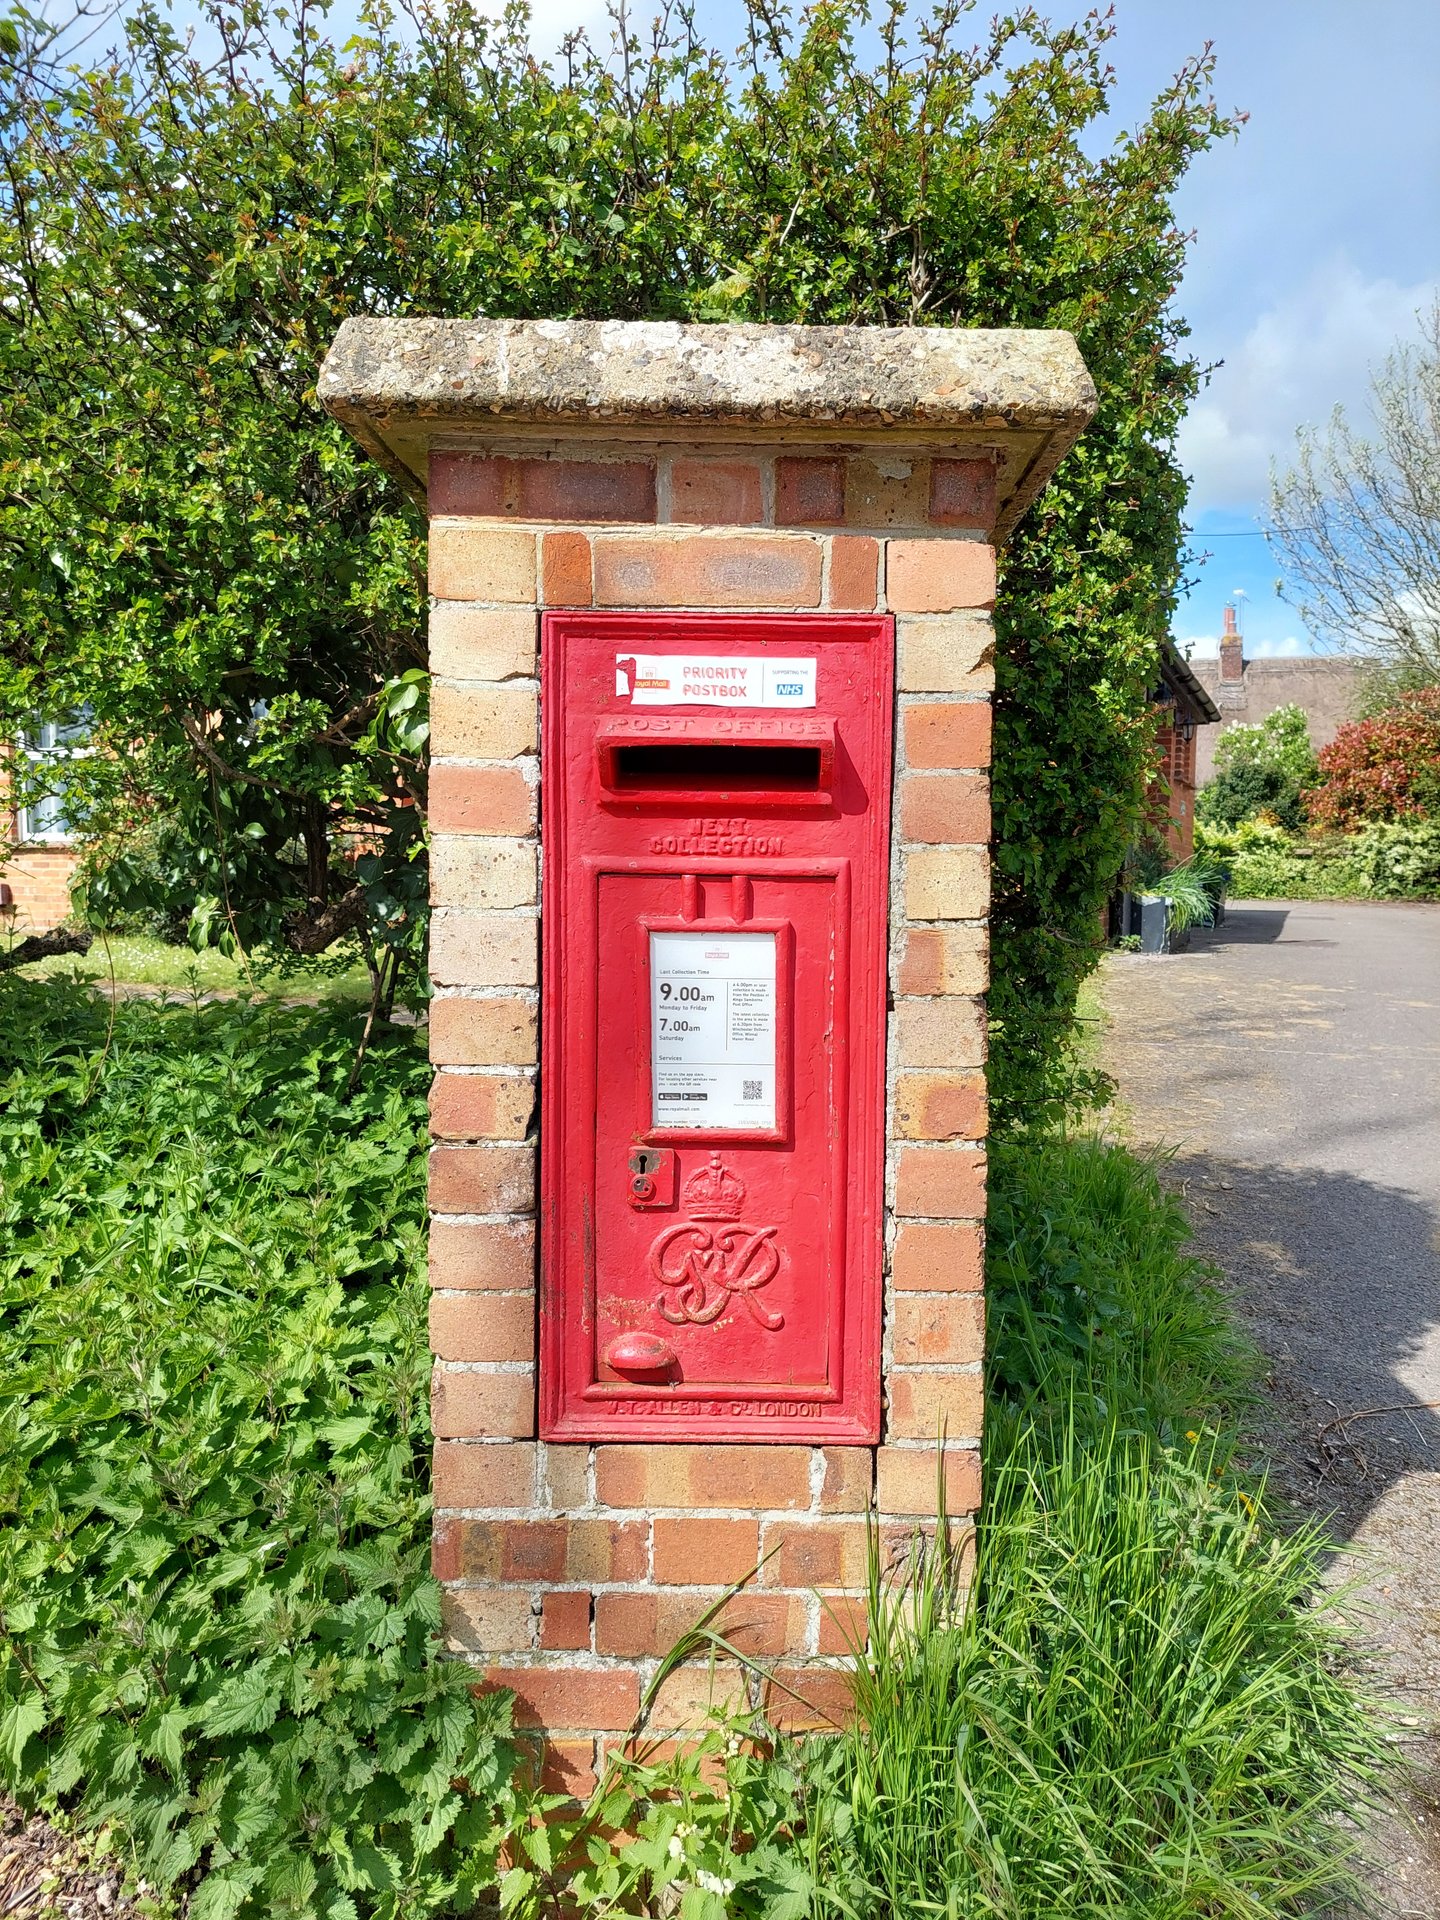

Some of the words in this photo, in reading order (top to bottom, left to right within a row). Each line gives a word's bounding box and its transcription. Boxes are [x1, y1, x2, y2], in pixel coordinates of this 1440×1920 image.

[682, 666, 748, 680] PRIORITY
[635, 680, 651, 688] oyal
[682, 684, 748, 698] POSTBOX
[777, 685, 803, 695] NHS
[606, 718, 696, 732] POST
[711, 719, 827, 735] OFFICE
[688, 818, 748, 837] NEXT
[650, 836, 784, 856] COLLECTION
[660, 982, 715, 1002] 9.00am
[659, 1018, 701, 1032] 7.00am
[645, 1400, 700, 1416] ALLEN
[755, 1401, 822, 1418] LONDON
